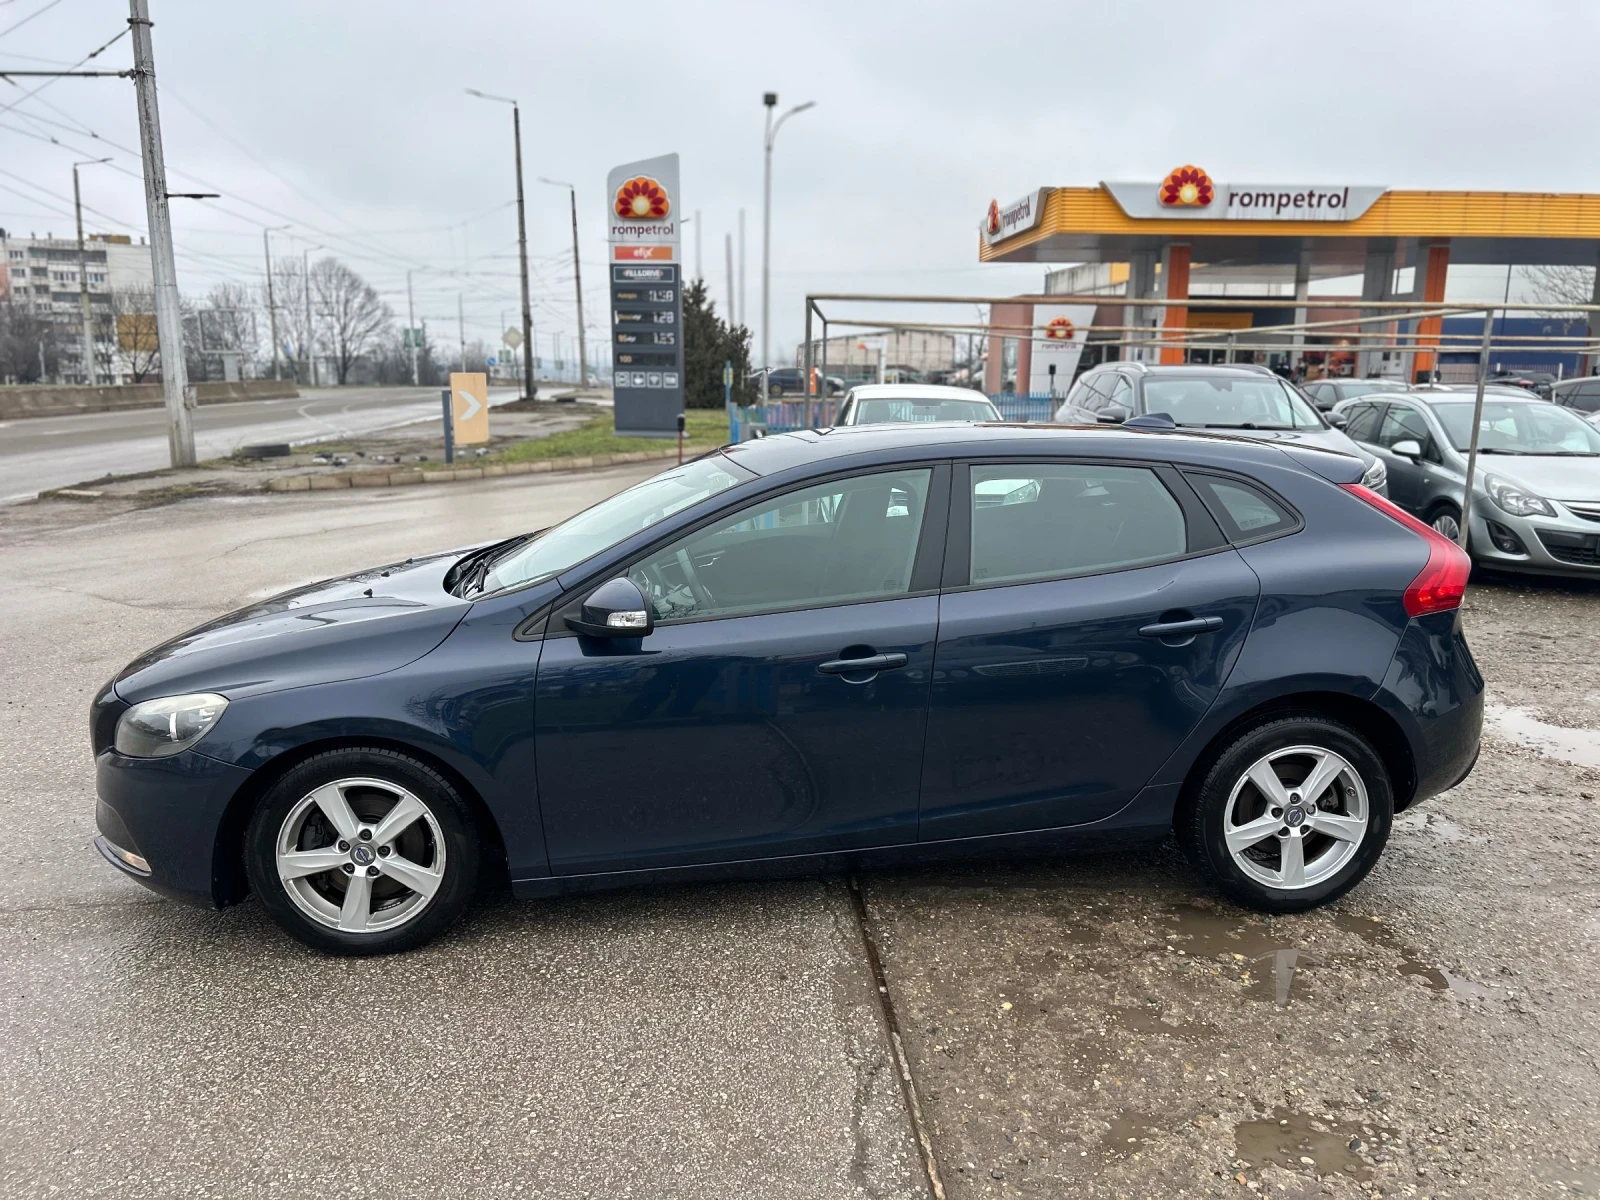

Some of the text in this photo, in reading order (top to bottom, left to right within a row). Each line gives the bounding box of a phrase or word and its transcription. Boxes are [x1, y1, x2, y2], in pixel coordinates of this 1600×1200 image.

[1002, 195, 1031, 230] rompetrol
[1228, 186, 1349, 215] rompetrol
[612, 222, 674, 239] rompetrol
